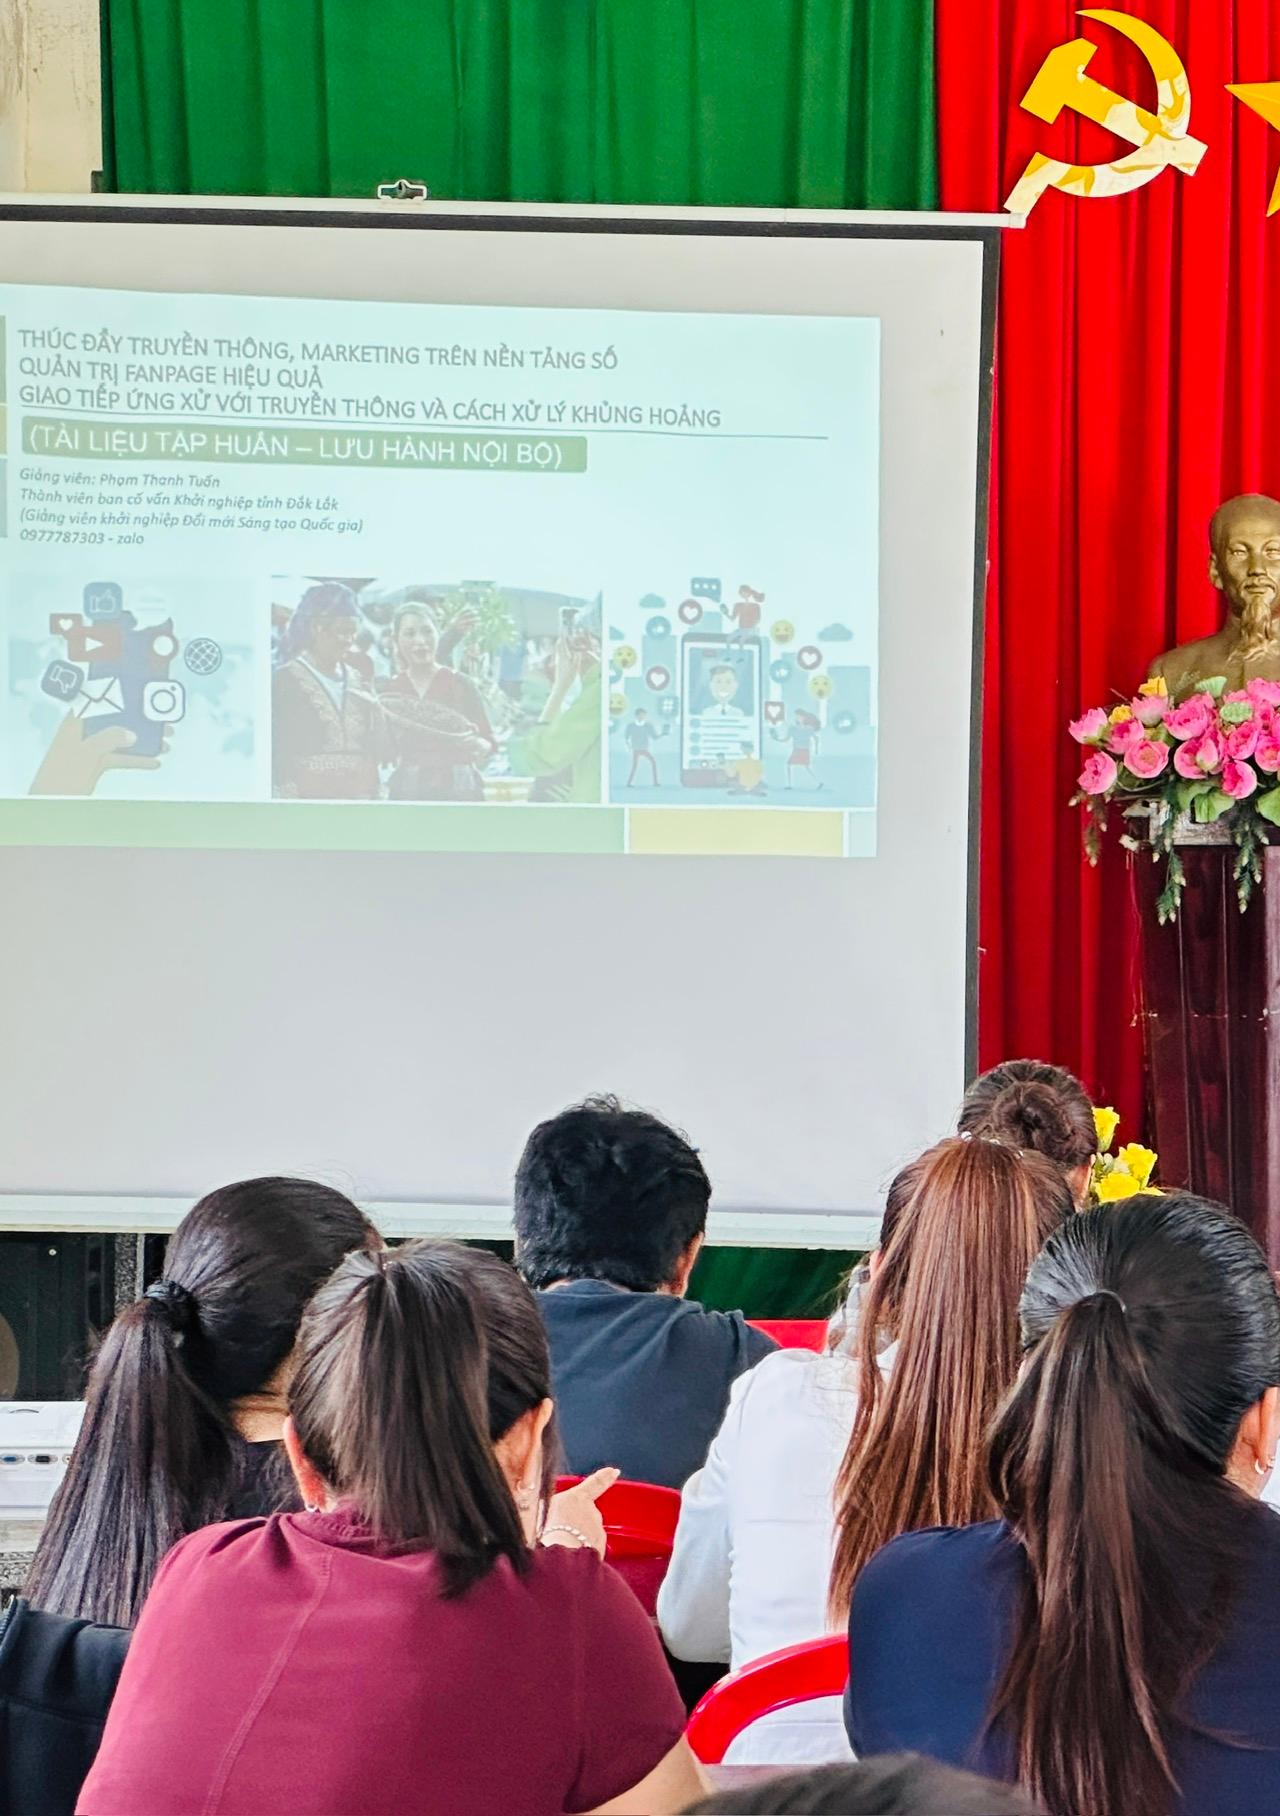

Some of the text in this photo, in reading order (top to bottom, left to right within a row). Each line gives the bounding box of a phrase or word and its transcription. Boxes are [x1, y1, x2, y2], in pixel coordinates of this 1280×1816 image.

[17, 327, 618, 369] THÚC ĐẨY TRUYỀN THÔNG, MARKETING TRÊN NỀN TẢNG SỐ
[19, 353, 323, 390] QUẢN TRỊ FANPAGE HIỆU QUẢ
[19, 382, 720, 428] GIAO TIẾP ỨNG XỬ VỚI TRUYỀN THÔNG VÀ CÁCH XỬ LÝ KHỦNG HOẢNG
[89, 429, 147, 456] LIỆU
[154, 431, 206, 458] TẬP
[320, 437, 373, 459] LƯU
[383, 438, 455, 462] HÀNH
[463, 442, 508, 468] NỘI
[517, 442, 563, 469] BỘ)
[19, 468, 220, 488] Giảng viên: Phạm Thanh Tuấn
[21, 488, 62, 502] Thành
[66, 492, 93, 504] viên
[97, 492, 123, 505] ban
[127, 492, 143, 505] cố
[146, 492, 170, 505] vấn
[174, 493, 205, 506] Khởi
[208, 496, 253, 510] nghiệp
[20, 507, 65, 526] (Giảng
[69, 512, 97, 525] viên
[100, 512, 130, 525] khởi
[133, 512, 179, 528] nghiệp
[237, 516, 271, 531] Sáng
[275, 519, 296, 530] tạo
[300, 517, 334, 531] Quốc
[337, 519, 363, 533] gia)
[20, 528, 105, 544] 0977787303
[117, 533, 144, 544] zalo
